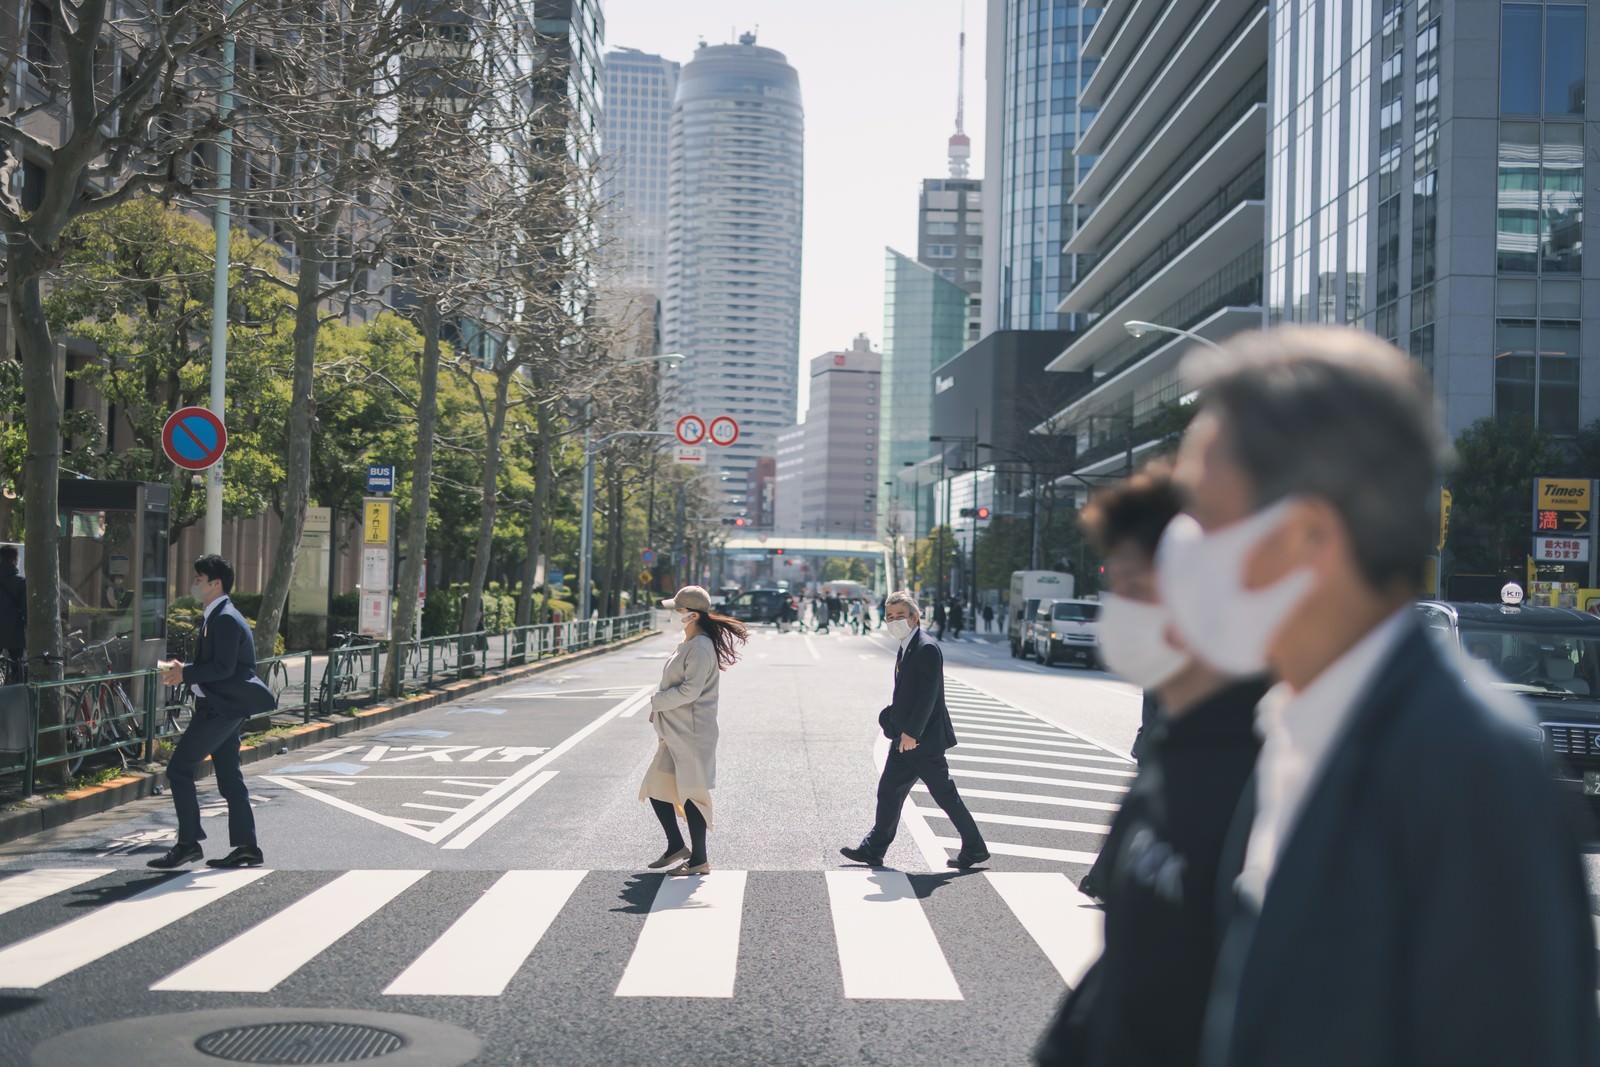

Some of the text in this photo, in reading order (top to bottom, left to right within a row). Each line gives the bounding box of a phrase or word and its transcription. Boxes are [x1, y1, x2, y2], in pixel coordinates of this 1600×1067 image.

[715, 424, 733, 438] 40
[370, 467, 390, 476] BUS
[1544, 484, 1585, 496] Times
[1539, 511, 1558, 529] 満
[1545, 540, 1580, 550] 最大料金
[1545, 550, 1580, 559] あります
[303, 745, 551, 762] バス停
